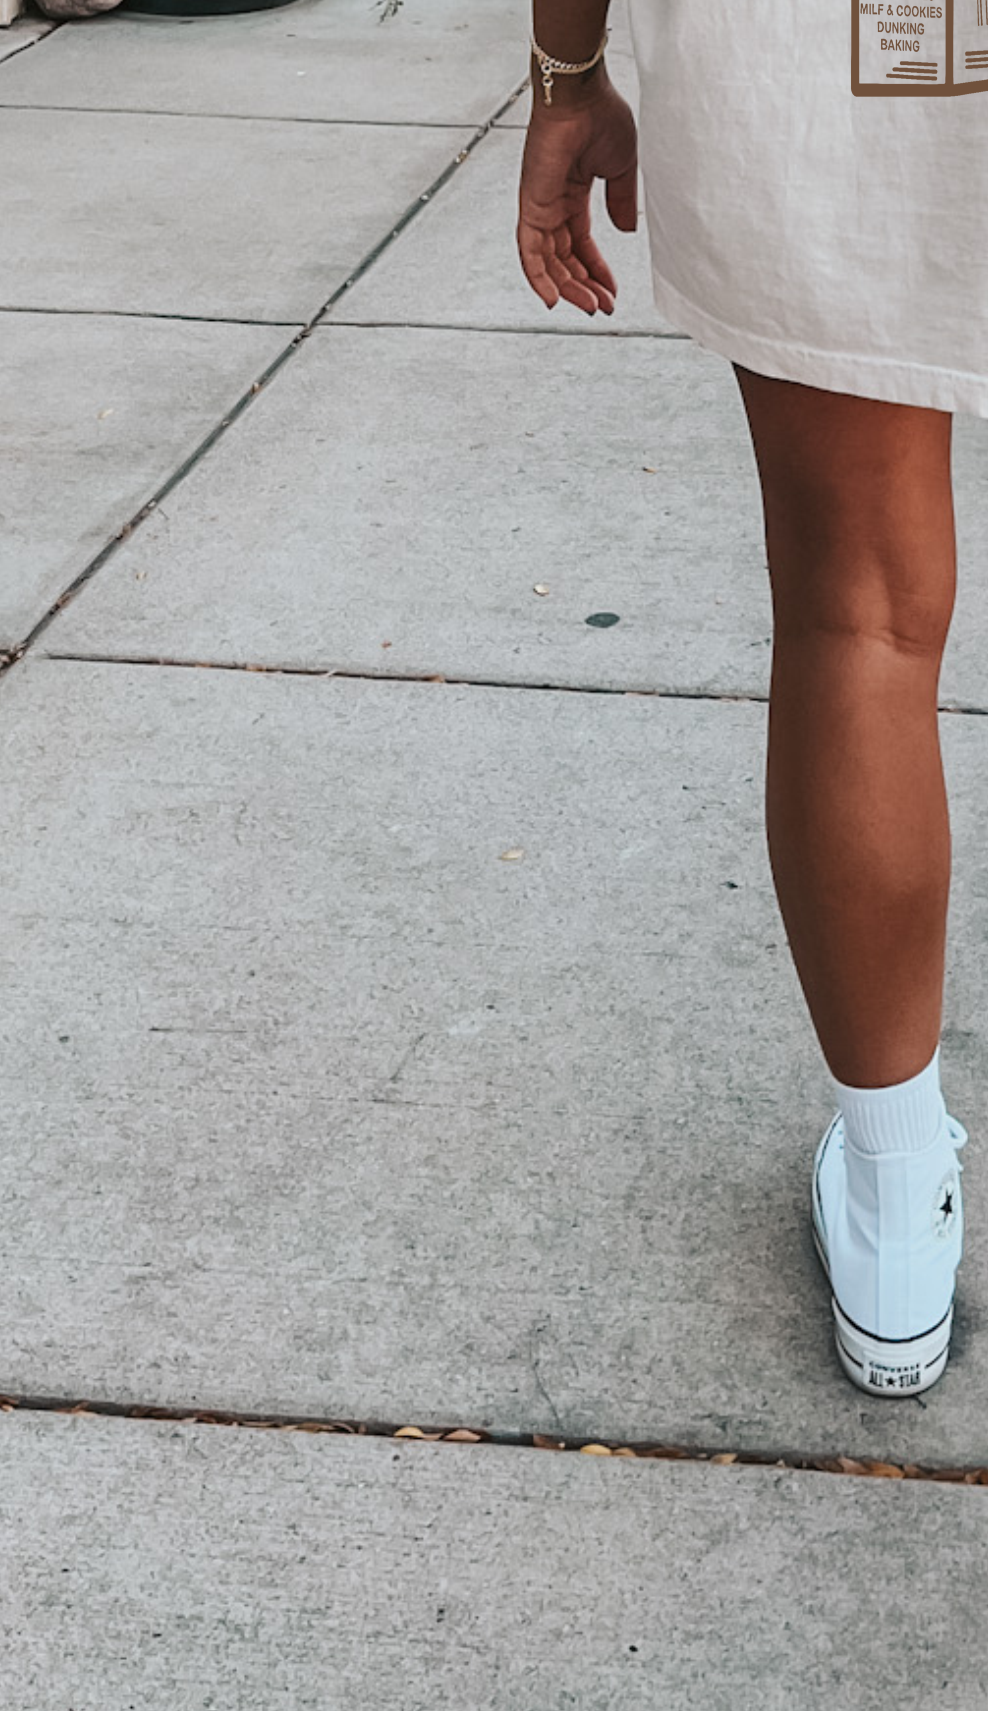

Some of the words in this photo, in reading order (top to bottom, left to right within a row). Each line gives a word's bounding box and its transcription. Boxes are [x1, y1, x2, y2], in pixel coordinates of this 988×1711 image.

[860, 3, 884, 15] MILF
[886, 4, 893, 16] &
[896, 4, 943, 19] COOKIES
[877, 21, 925, 35] DUNKING
[880, 38, 920, 53] BAKING
[868, 1370, 883, 1388] ALL
